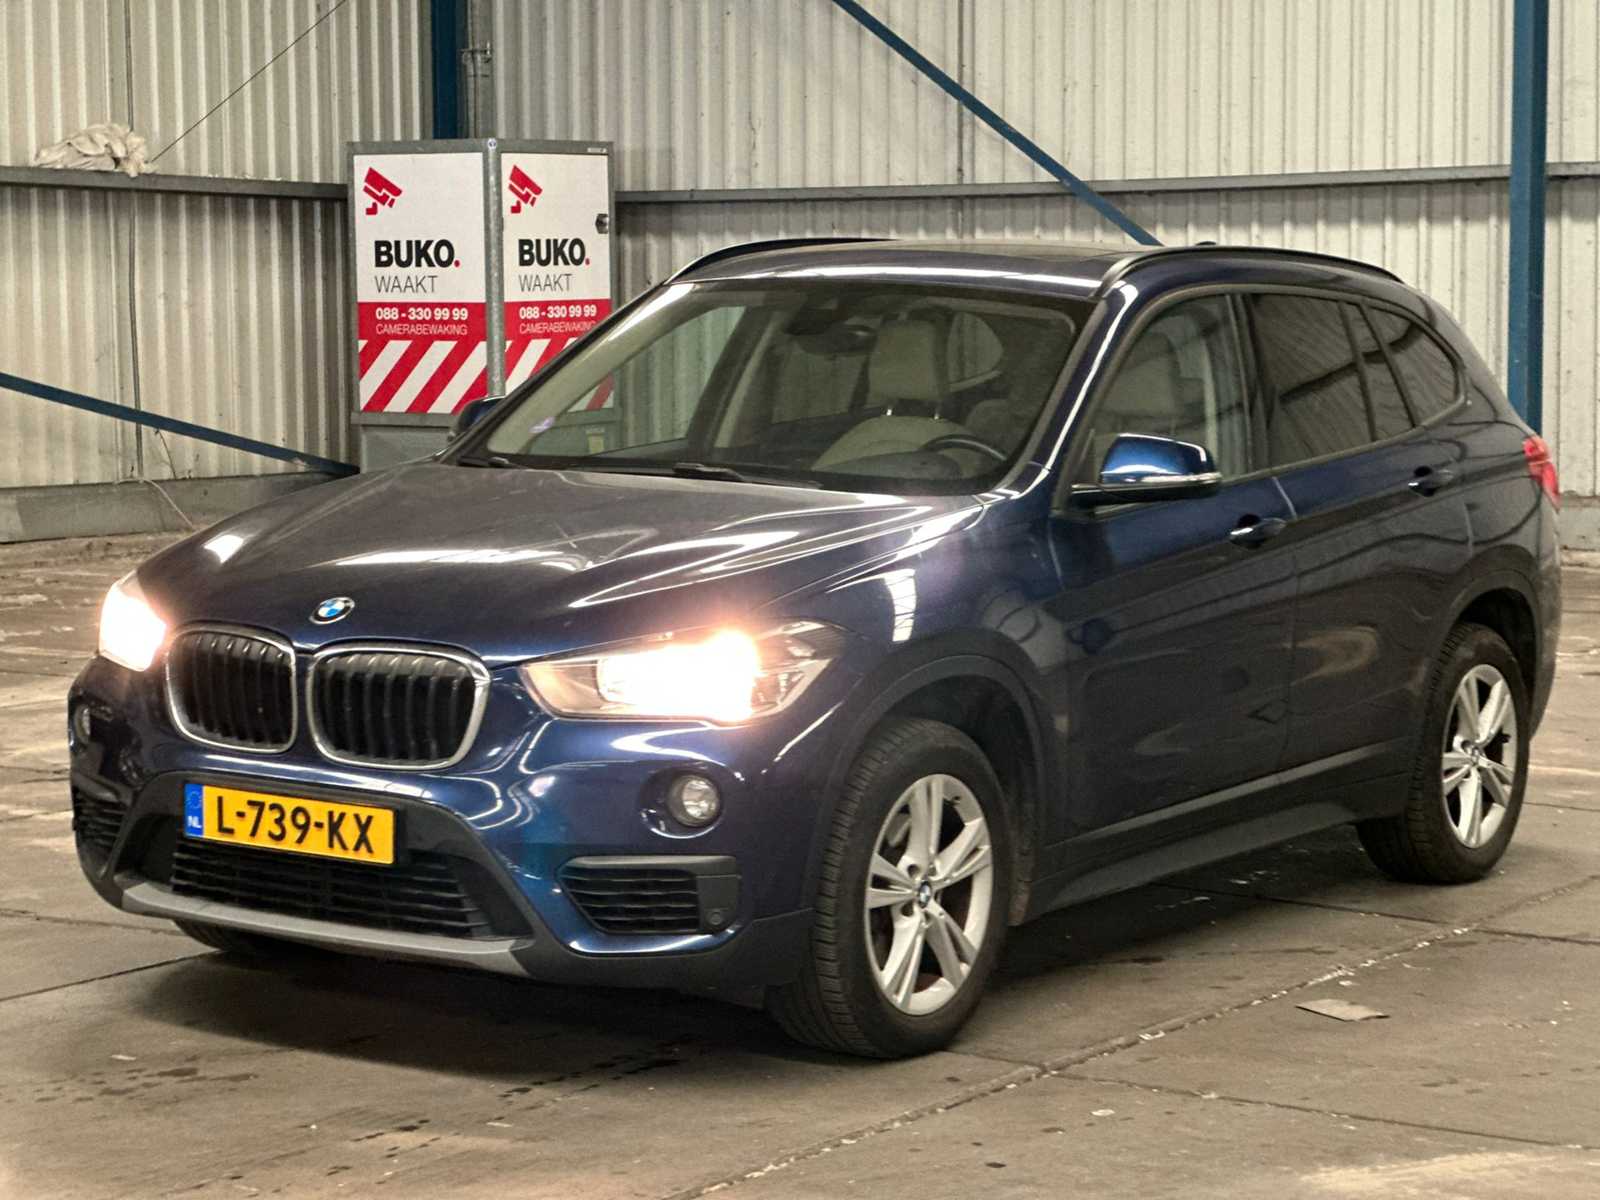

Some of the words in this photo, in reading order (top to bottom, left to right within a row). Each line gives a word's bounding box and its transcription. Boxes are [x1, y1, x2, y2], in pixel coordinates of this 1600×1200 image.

[374, 239, 460, 268] BUKO.
[518, 238, 590, 267] BUKO.
[374, 275, 438, 293] WAAKT
[518, 273, 573, 292] WAAKT
[375, 307, 399, 320] 088
[408, 307, 431, 320] 330
[434, 307, 450, 320] 99
[452, 307, 468, 320] 99
[519, 306, 540, 319] 088
[547, 305, 567, 318] 330
[568, 304, 582, 317] 99
[583, 304, 597, 317] 99
[375, 323, 468, 335] CAMERABEWAKING
[187, 815, 202, 829] NL
[217, 795, 374, 854] L-739-KX
